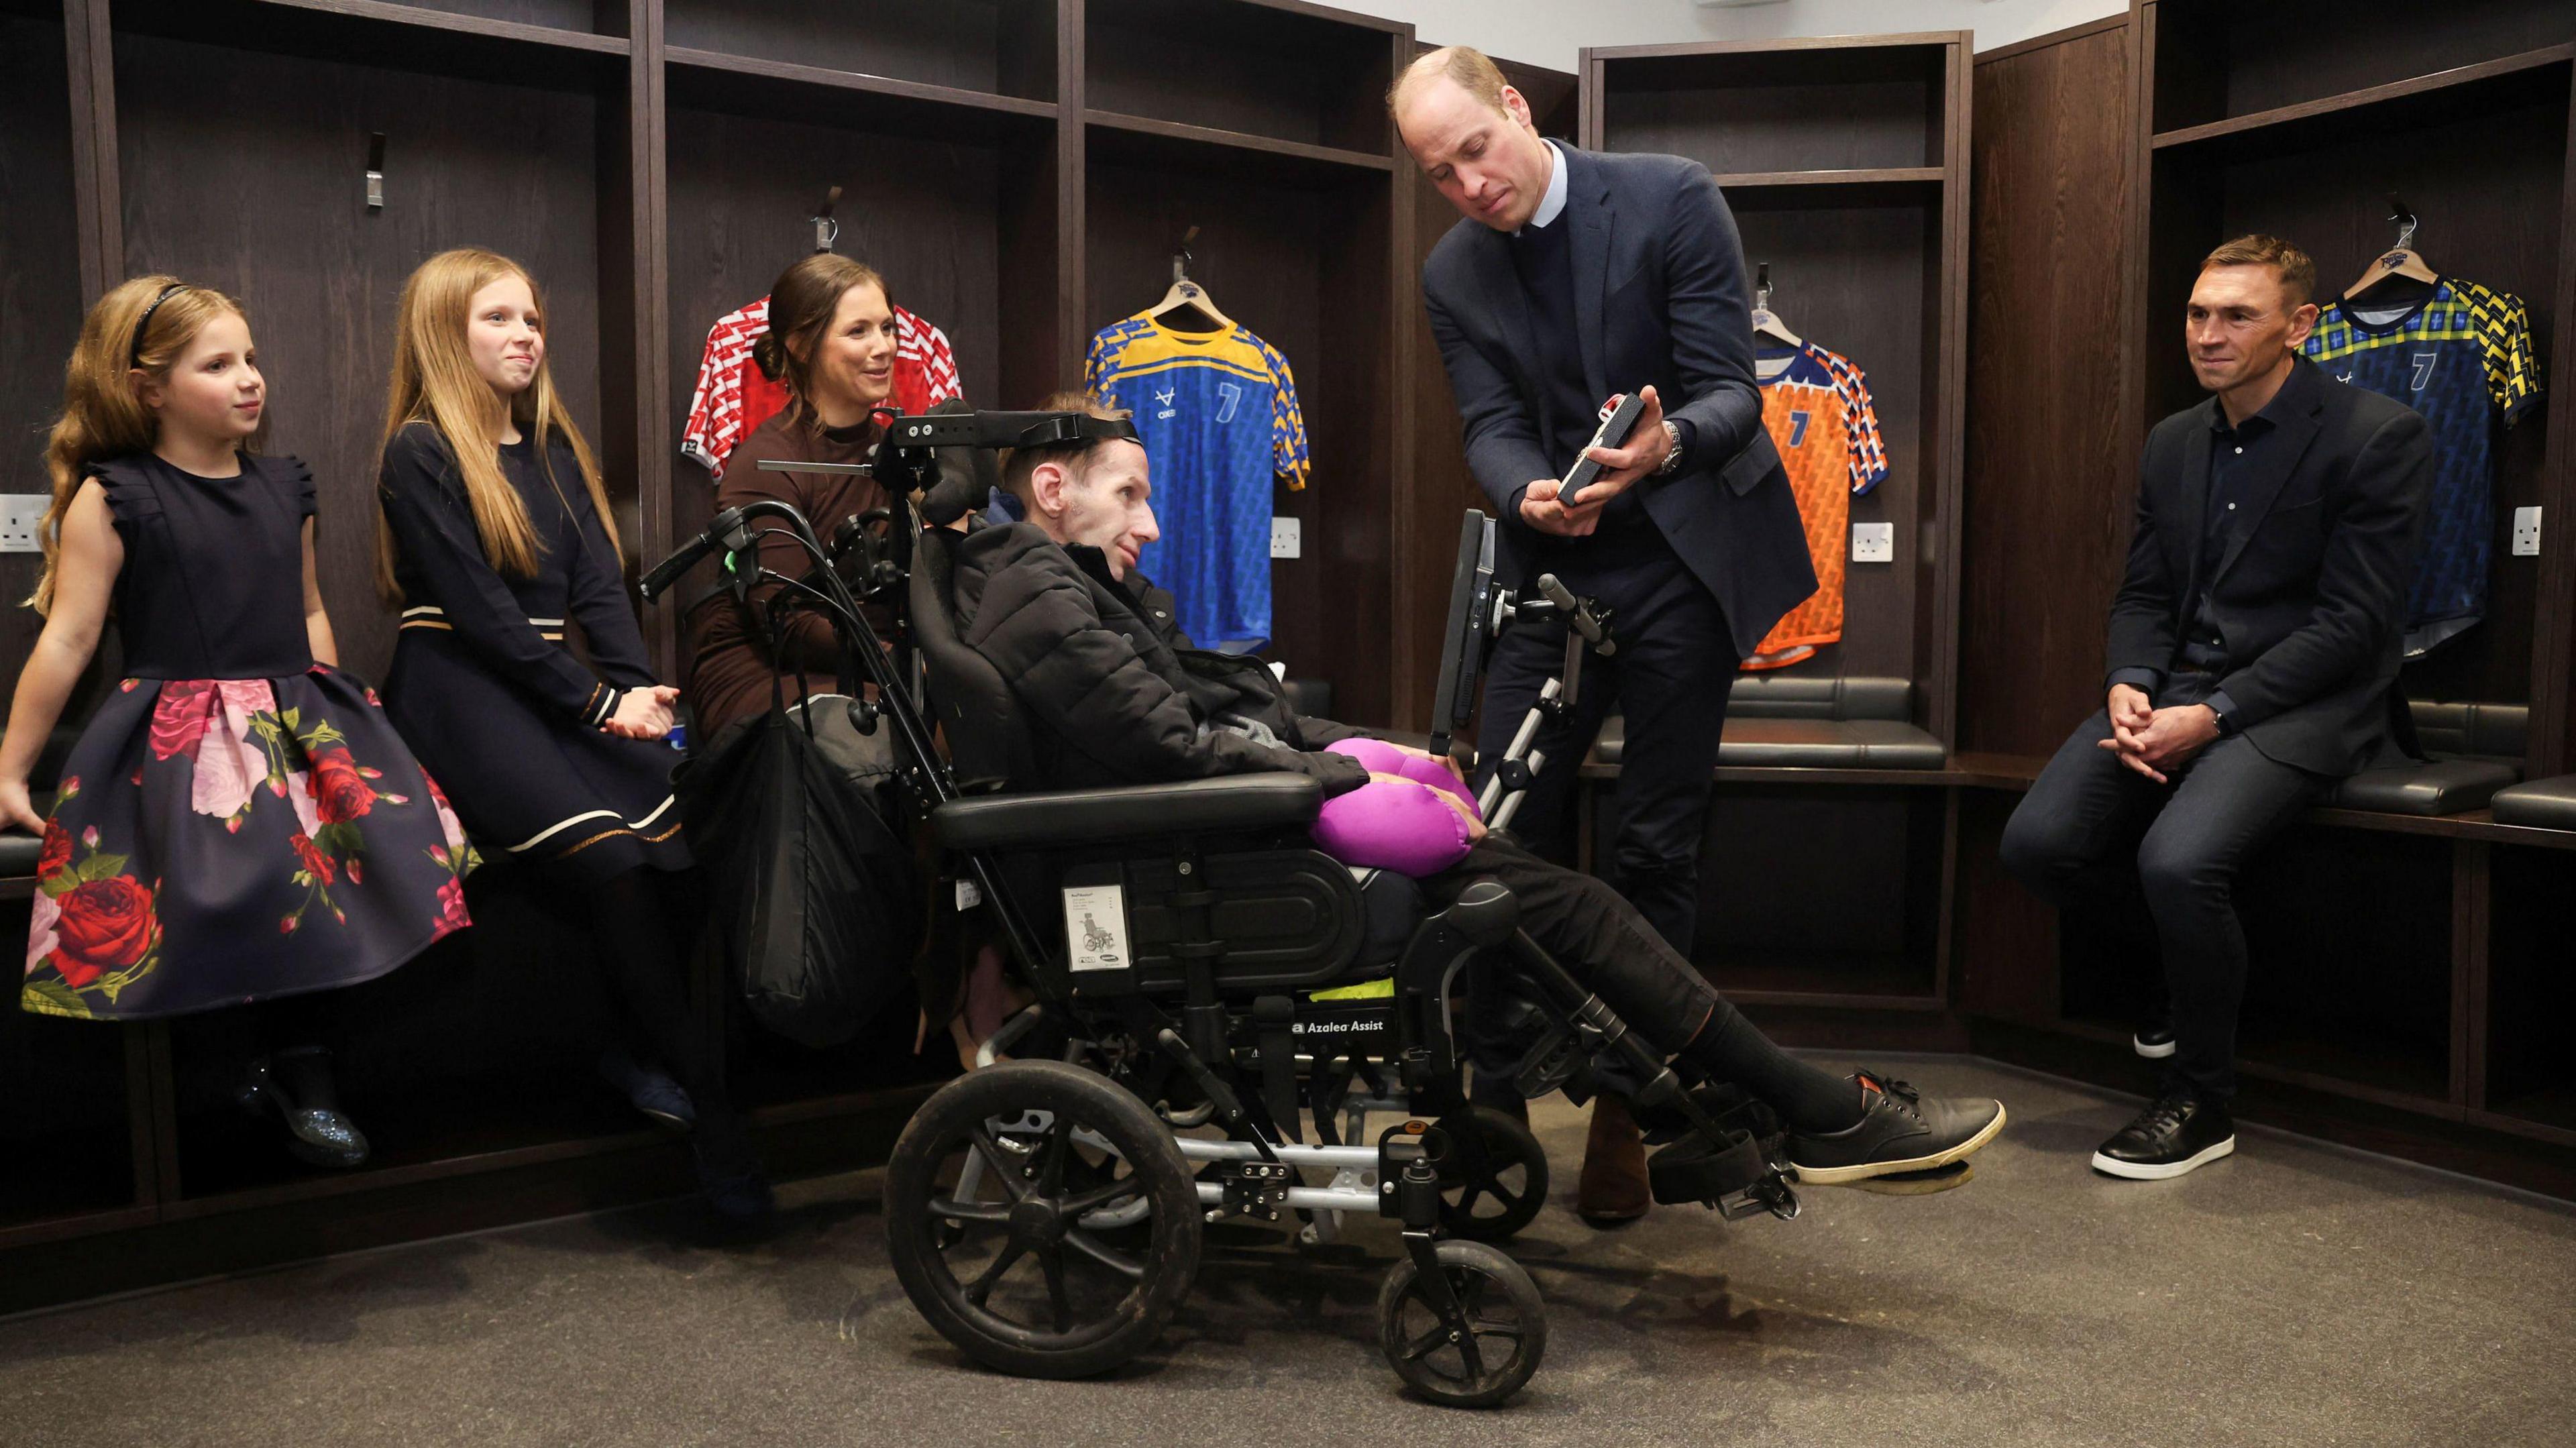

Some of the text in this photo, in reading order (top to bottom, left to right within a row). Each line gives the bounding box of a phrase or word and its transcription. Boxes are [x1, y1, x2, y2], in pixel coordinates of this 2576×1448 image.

[2410, 353, 2437, 391] 7
[1215, 382, 1242, 424] 7
[1788, 410, 1811, 448] 7
[1307, 1021, 1348, 1033] Azalea
[1350, 1021, 1383, 1032] Assist
